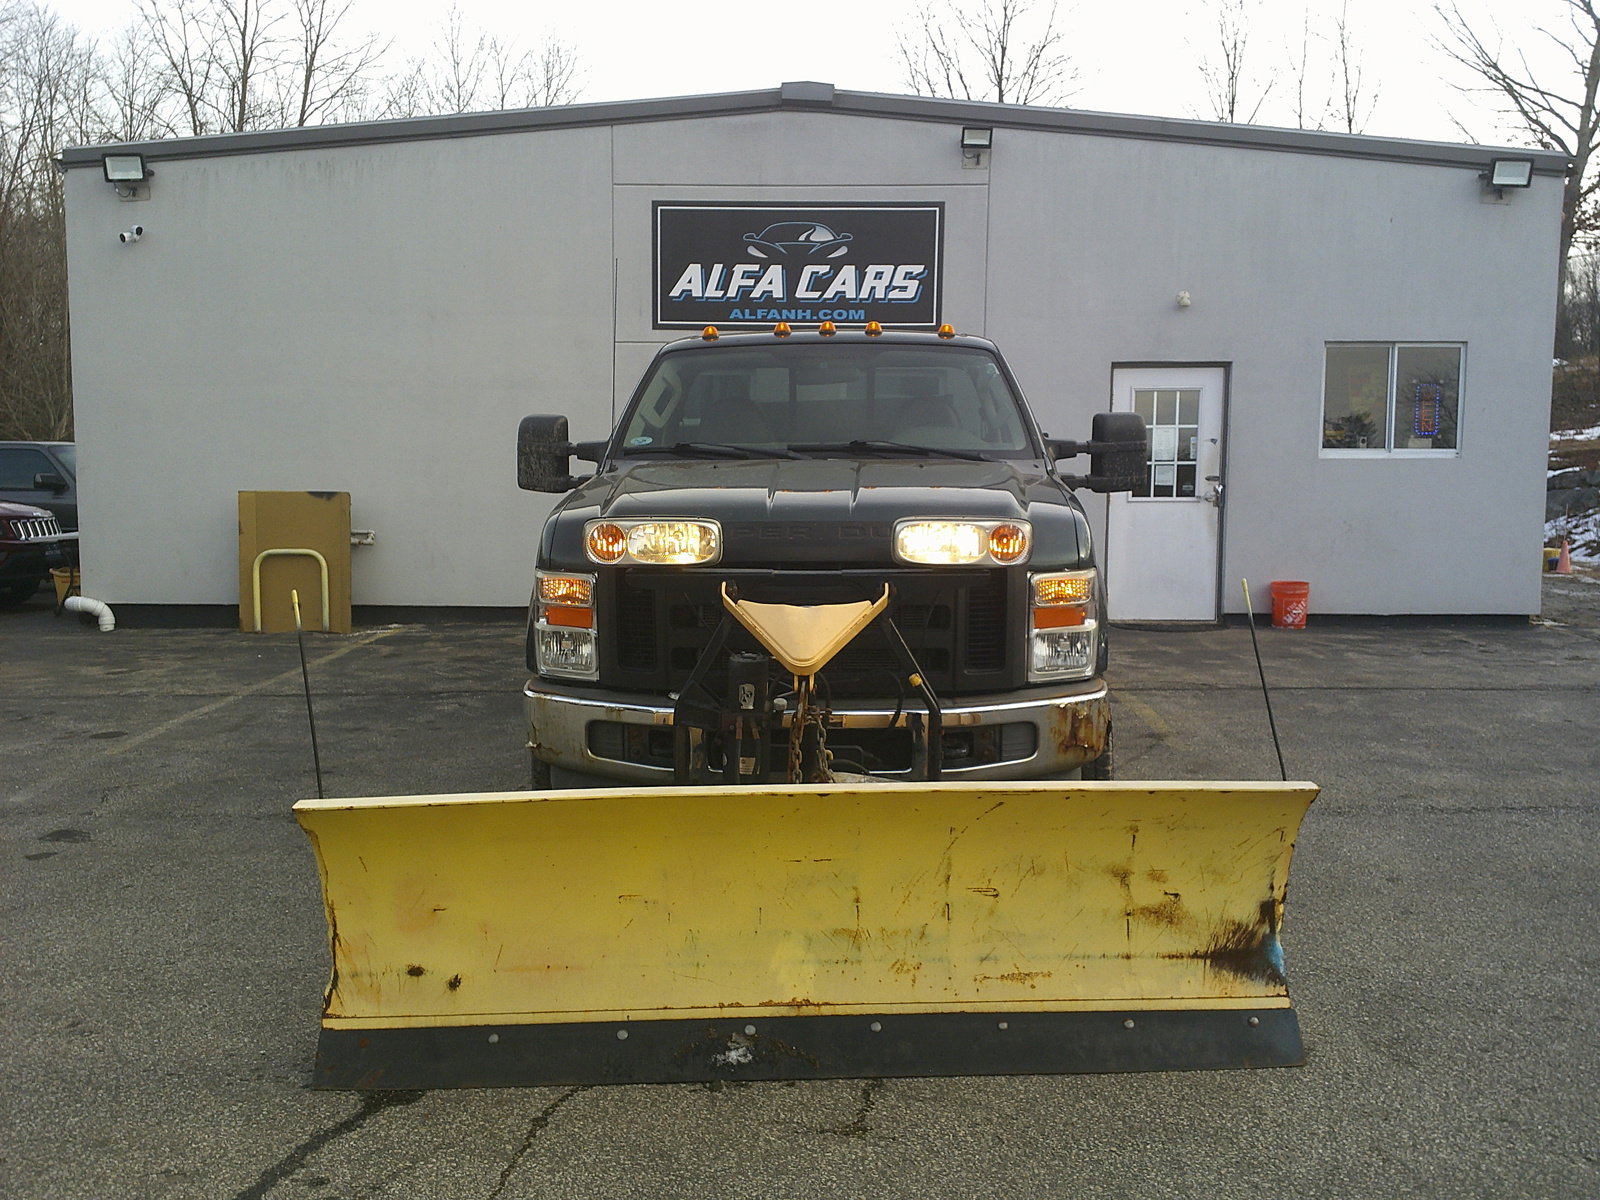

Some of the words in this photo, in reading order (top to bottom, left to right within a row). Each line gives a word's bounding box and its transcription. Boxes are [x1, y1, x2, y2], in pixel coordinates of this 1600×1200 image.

[668, 264, 786, 301] ALFA
[795, 264, 927, 302] CARS
[729, 308, 865, 320] ALFANH.COM
[729, 526, 816, 540] PER
